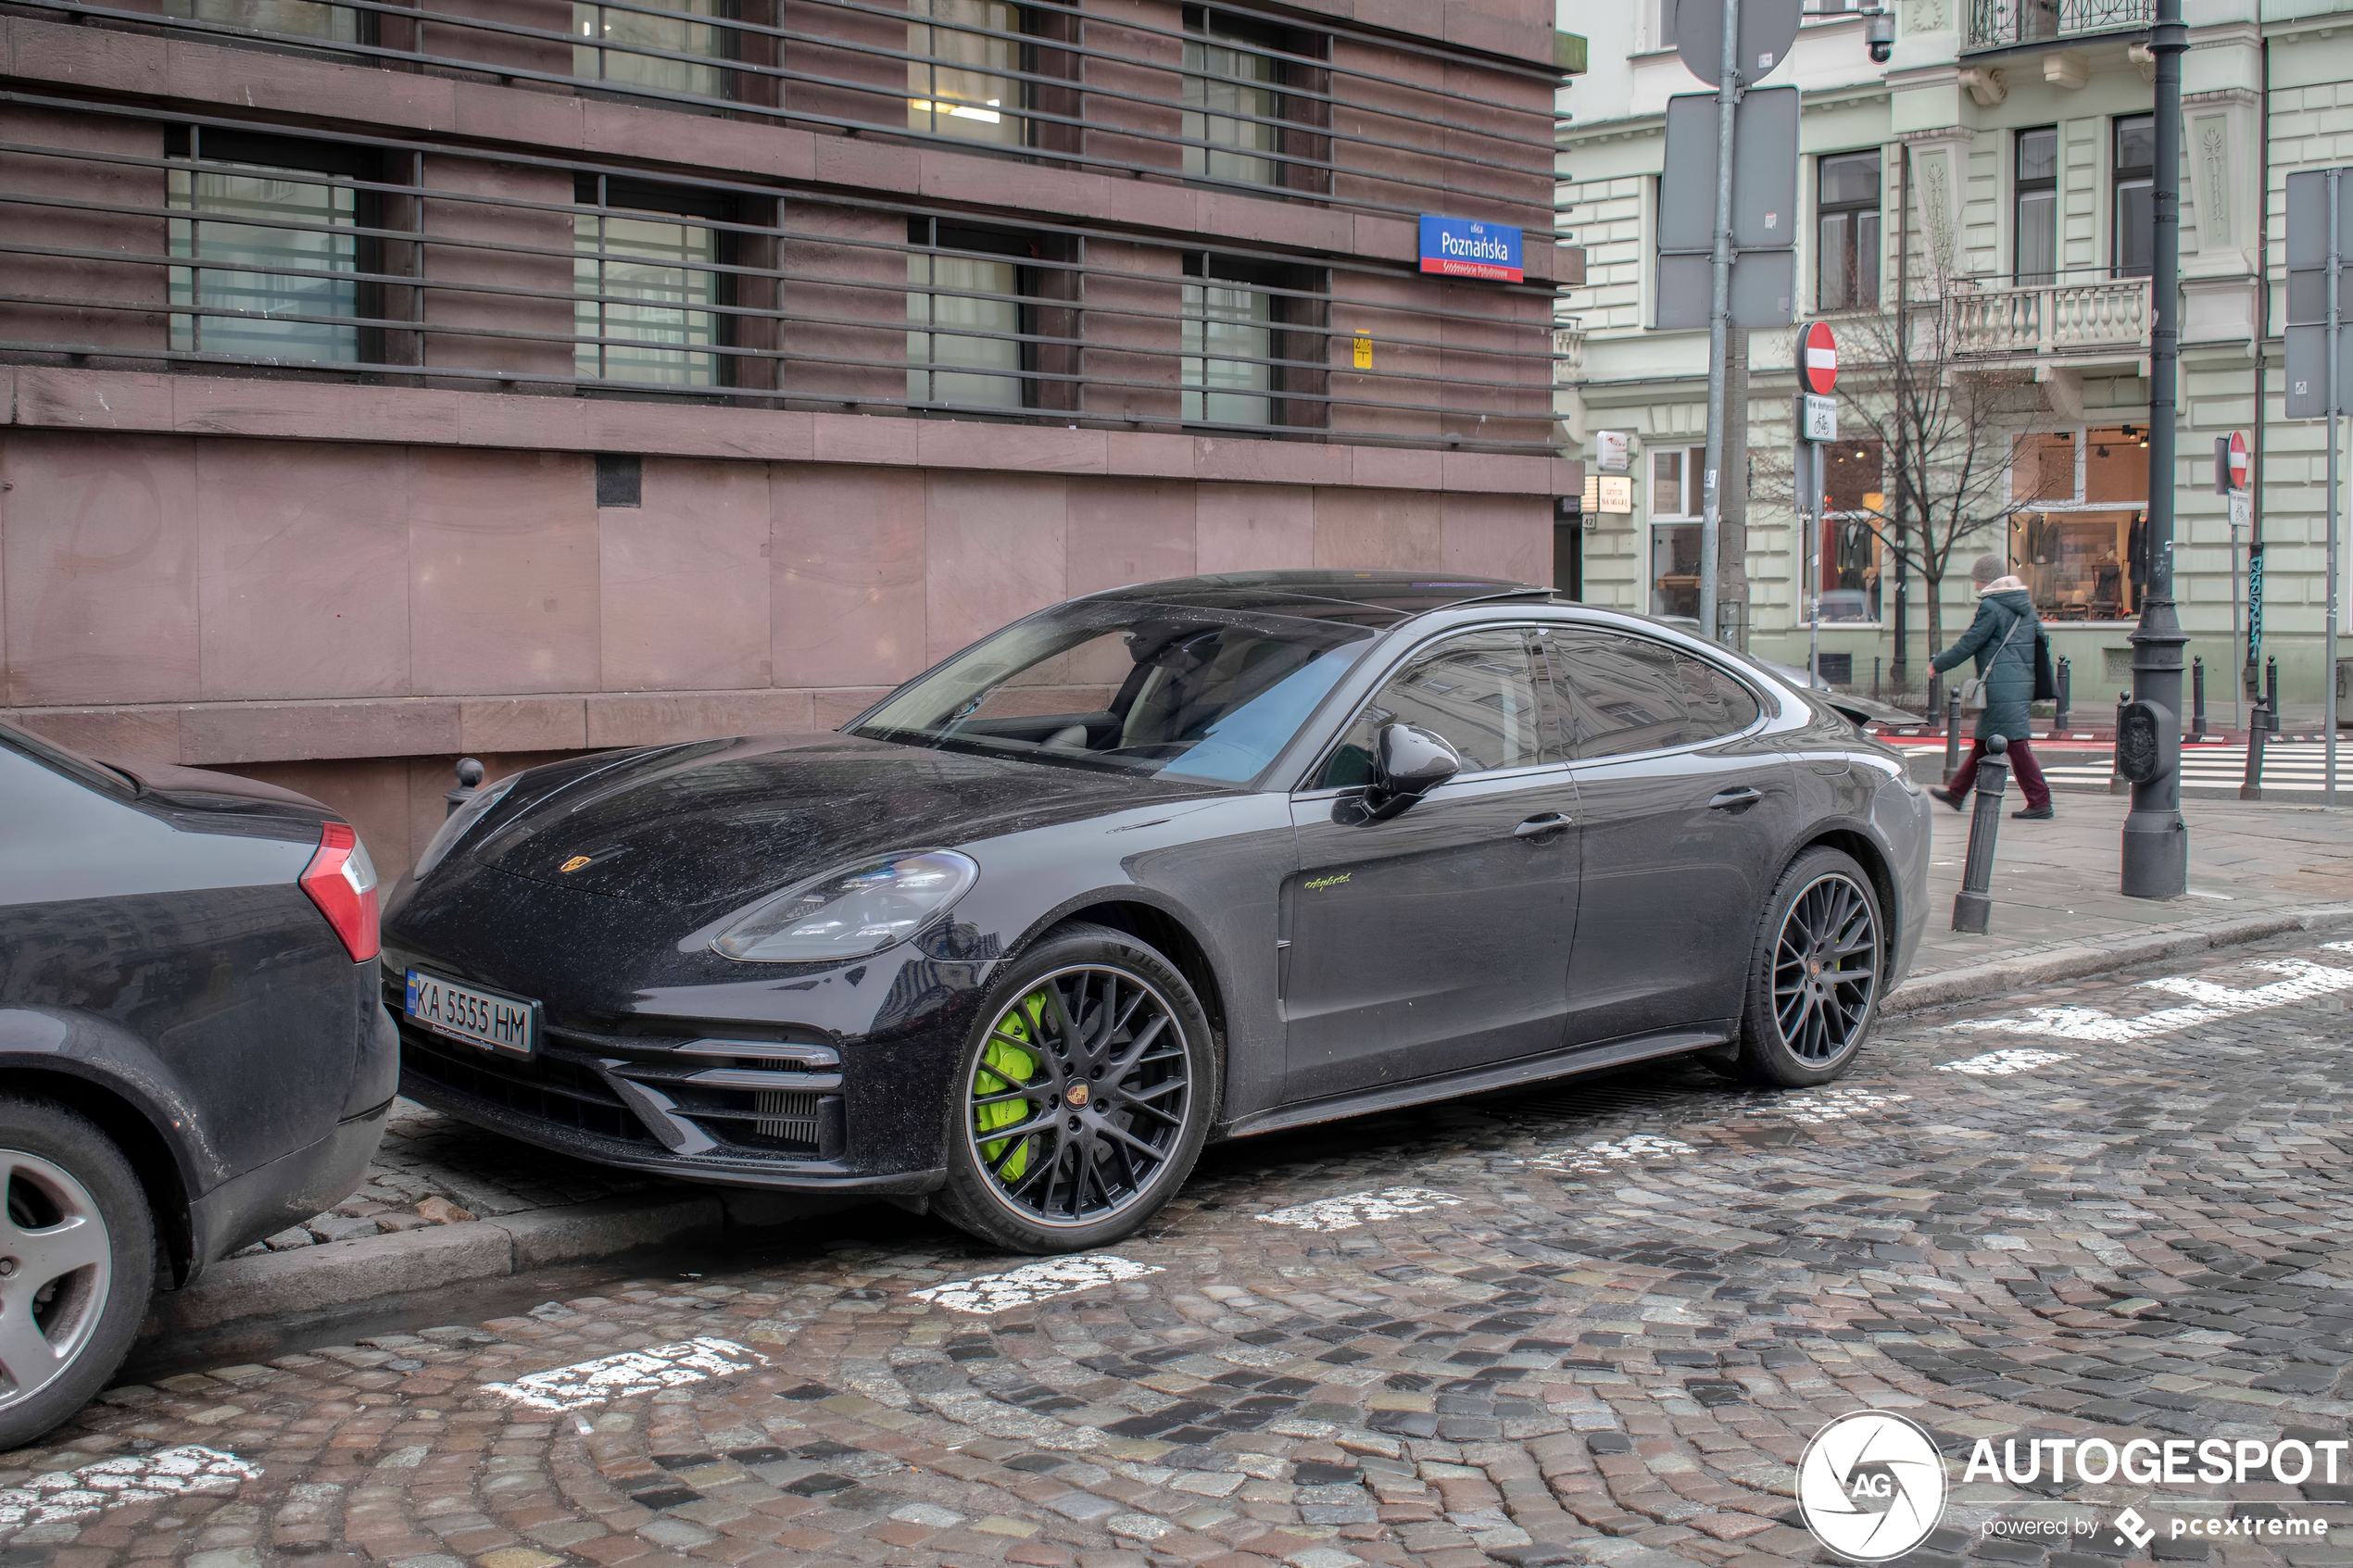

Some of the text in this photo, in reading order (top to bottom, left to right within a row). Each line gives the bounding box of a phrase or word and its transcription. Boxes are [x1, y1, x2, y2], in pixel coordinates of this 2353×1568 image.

[1441, 231, 1508, 261] Poznańska
[417, 979, 442, 1020] KA
[446, 989, 490, 1034] 5555
[495, 1003, 527, 1046] HM
